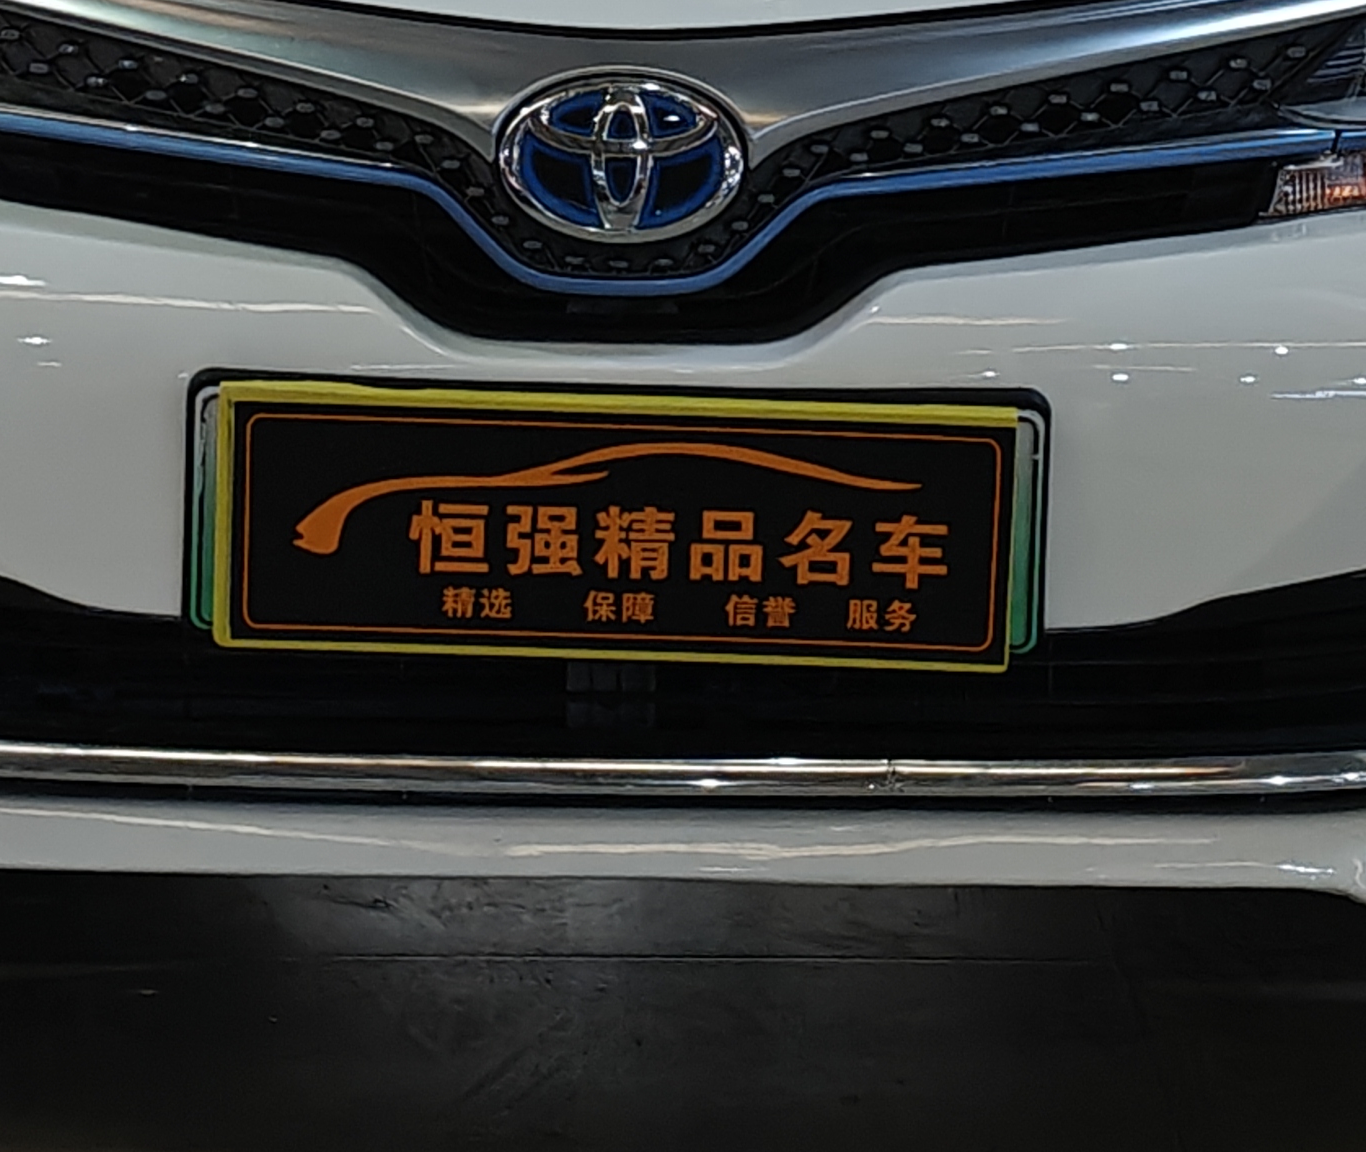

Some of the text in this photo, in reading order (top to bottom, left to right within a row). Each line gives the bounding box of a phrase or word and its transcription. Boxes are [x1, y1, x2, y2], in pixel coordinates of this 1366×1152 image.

[409, 499, 949, 590] 恒强精品名车
[441, 585, 918, 632] 精选 保障 信誉 服务
